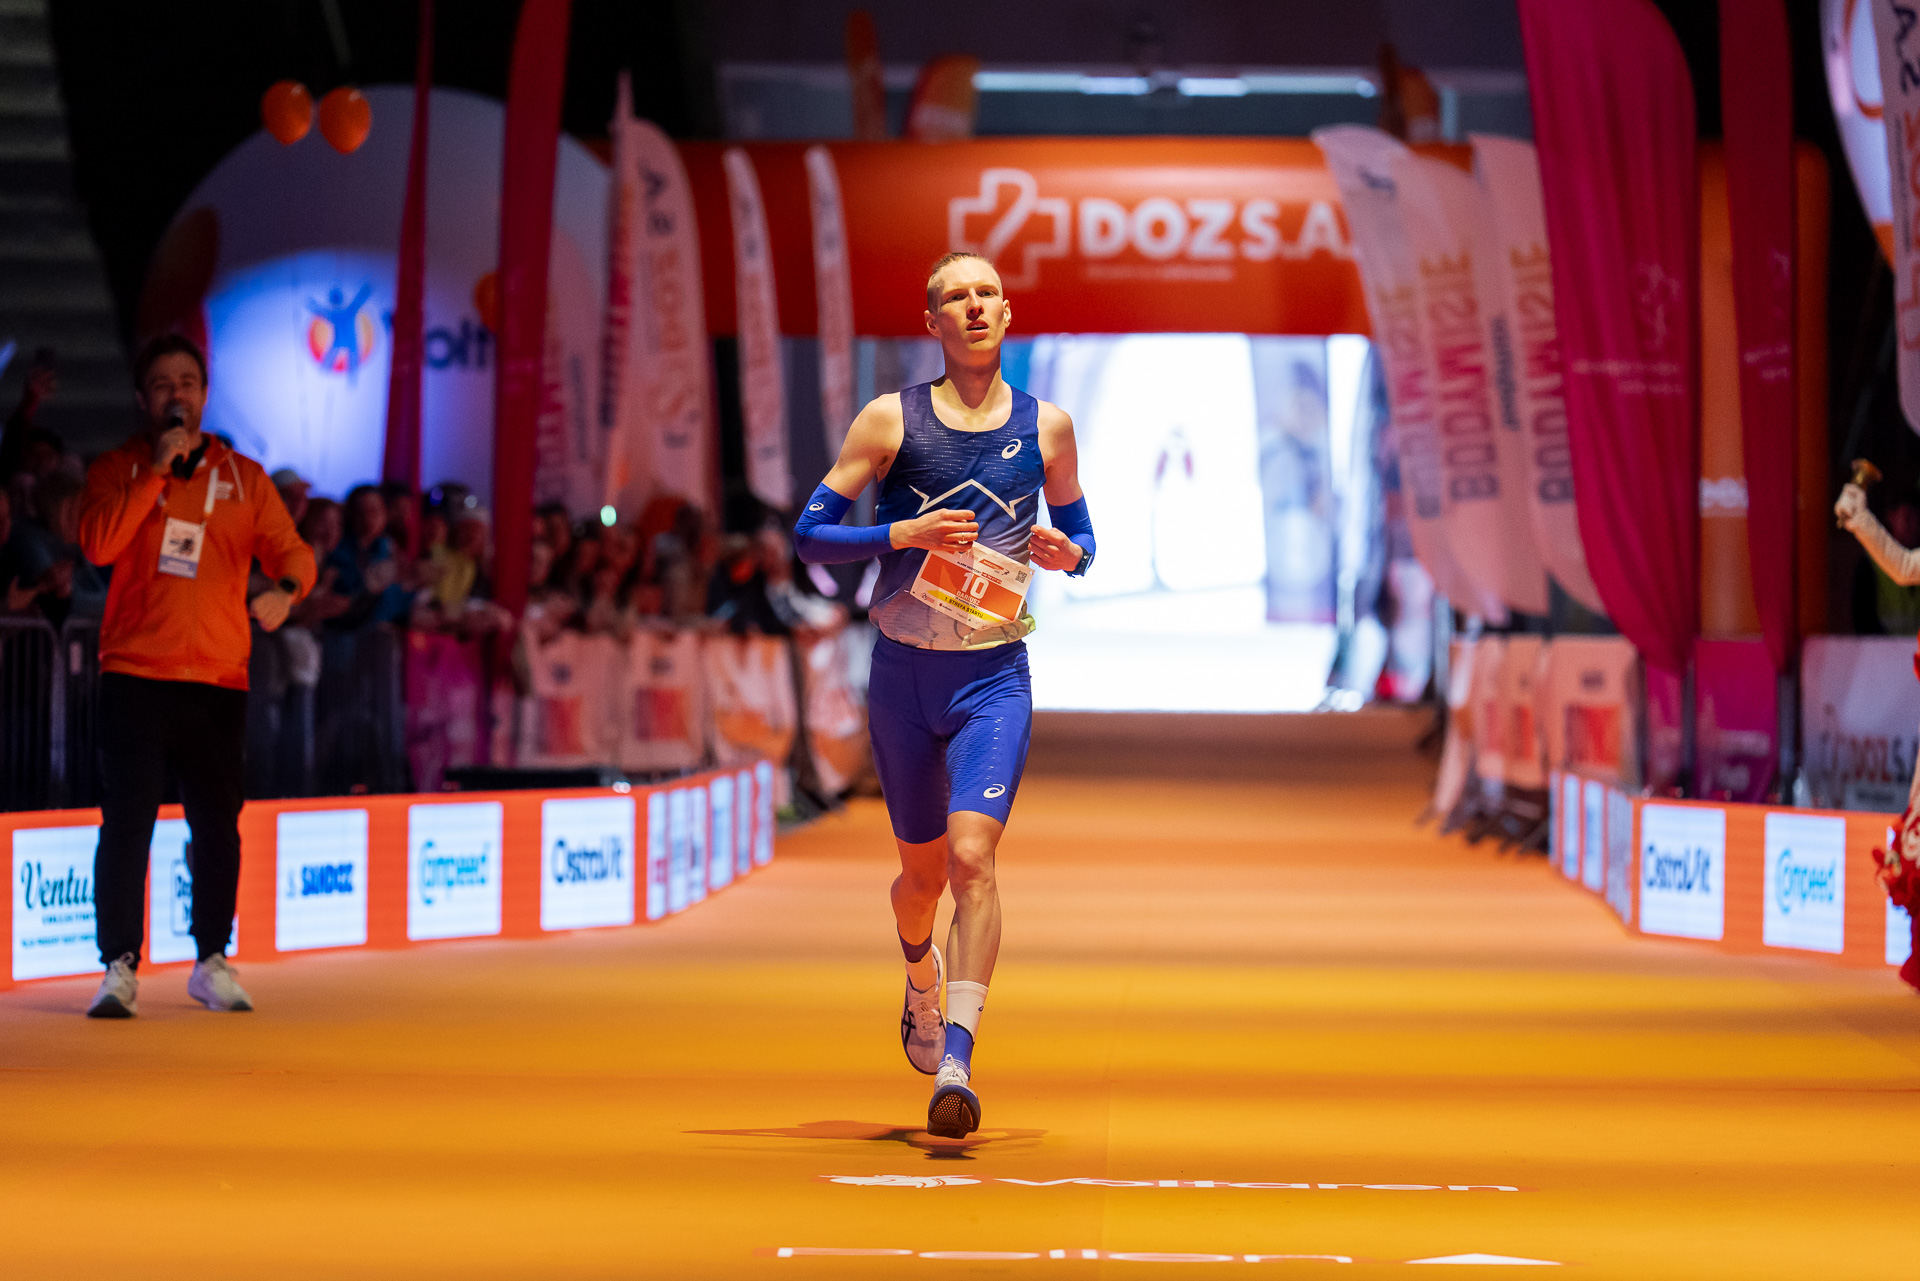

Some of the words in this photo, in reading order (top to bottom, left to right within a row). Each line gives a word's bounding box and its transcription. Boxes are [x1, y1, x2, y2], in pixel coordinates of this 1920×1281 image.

[1078, 198, 1235, 261] DOZ
[956, 590, 981, 606] DARIUSZ
[962, 572, 989, 599] 10
[21, 861, 96, 910] Ventu
